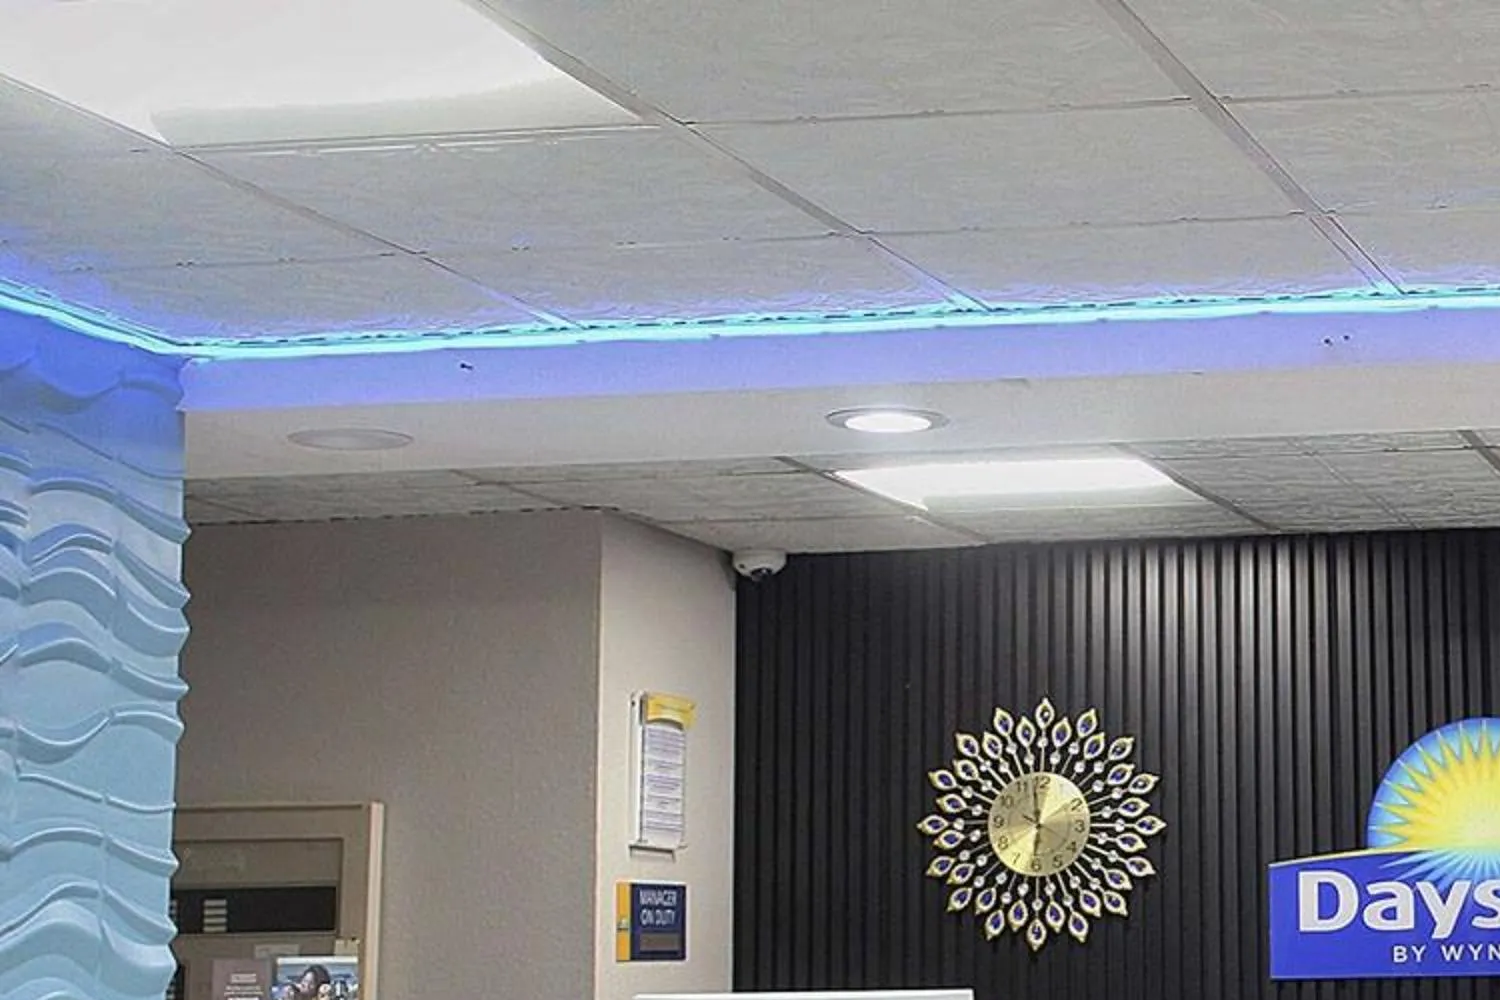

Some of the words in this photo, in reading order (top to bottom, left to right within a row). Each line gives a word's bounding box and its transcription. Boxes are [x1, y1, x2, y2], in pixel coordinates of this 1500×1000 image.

[639, 889, 678, 907] MANAGER
[640, 908, 654, 926] ON
[655, 909, 677, 926] DUTY
[1393, 945, 1426, 963] BY
